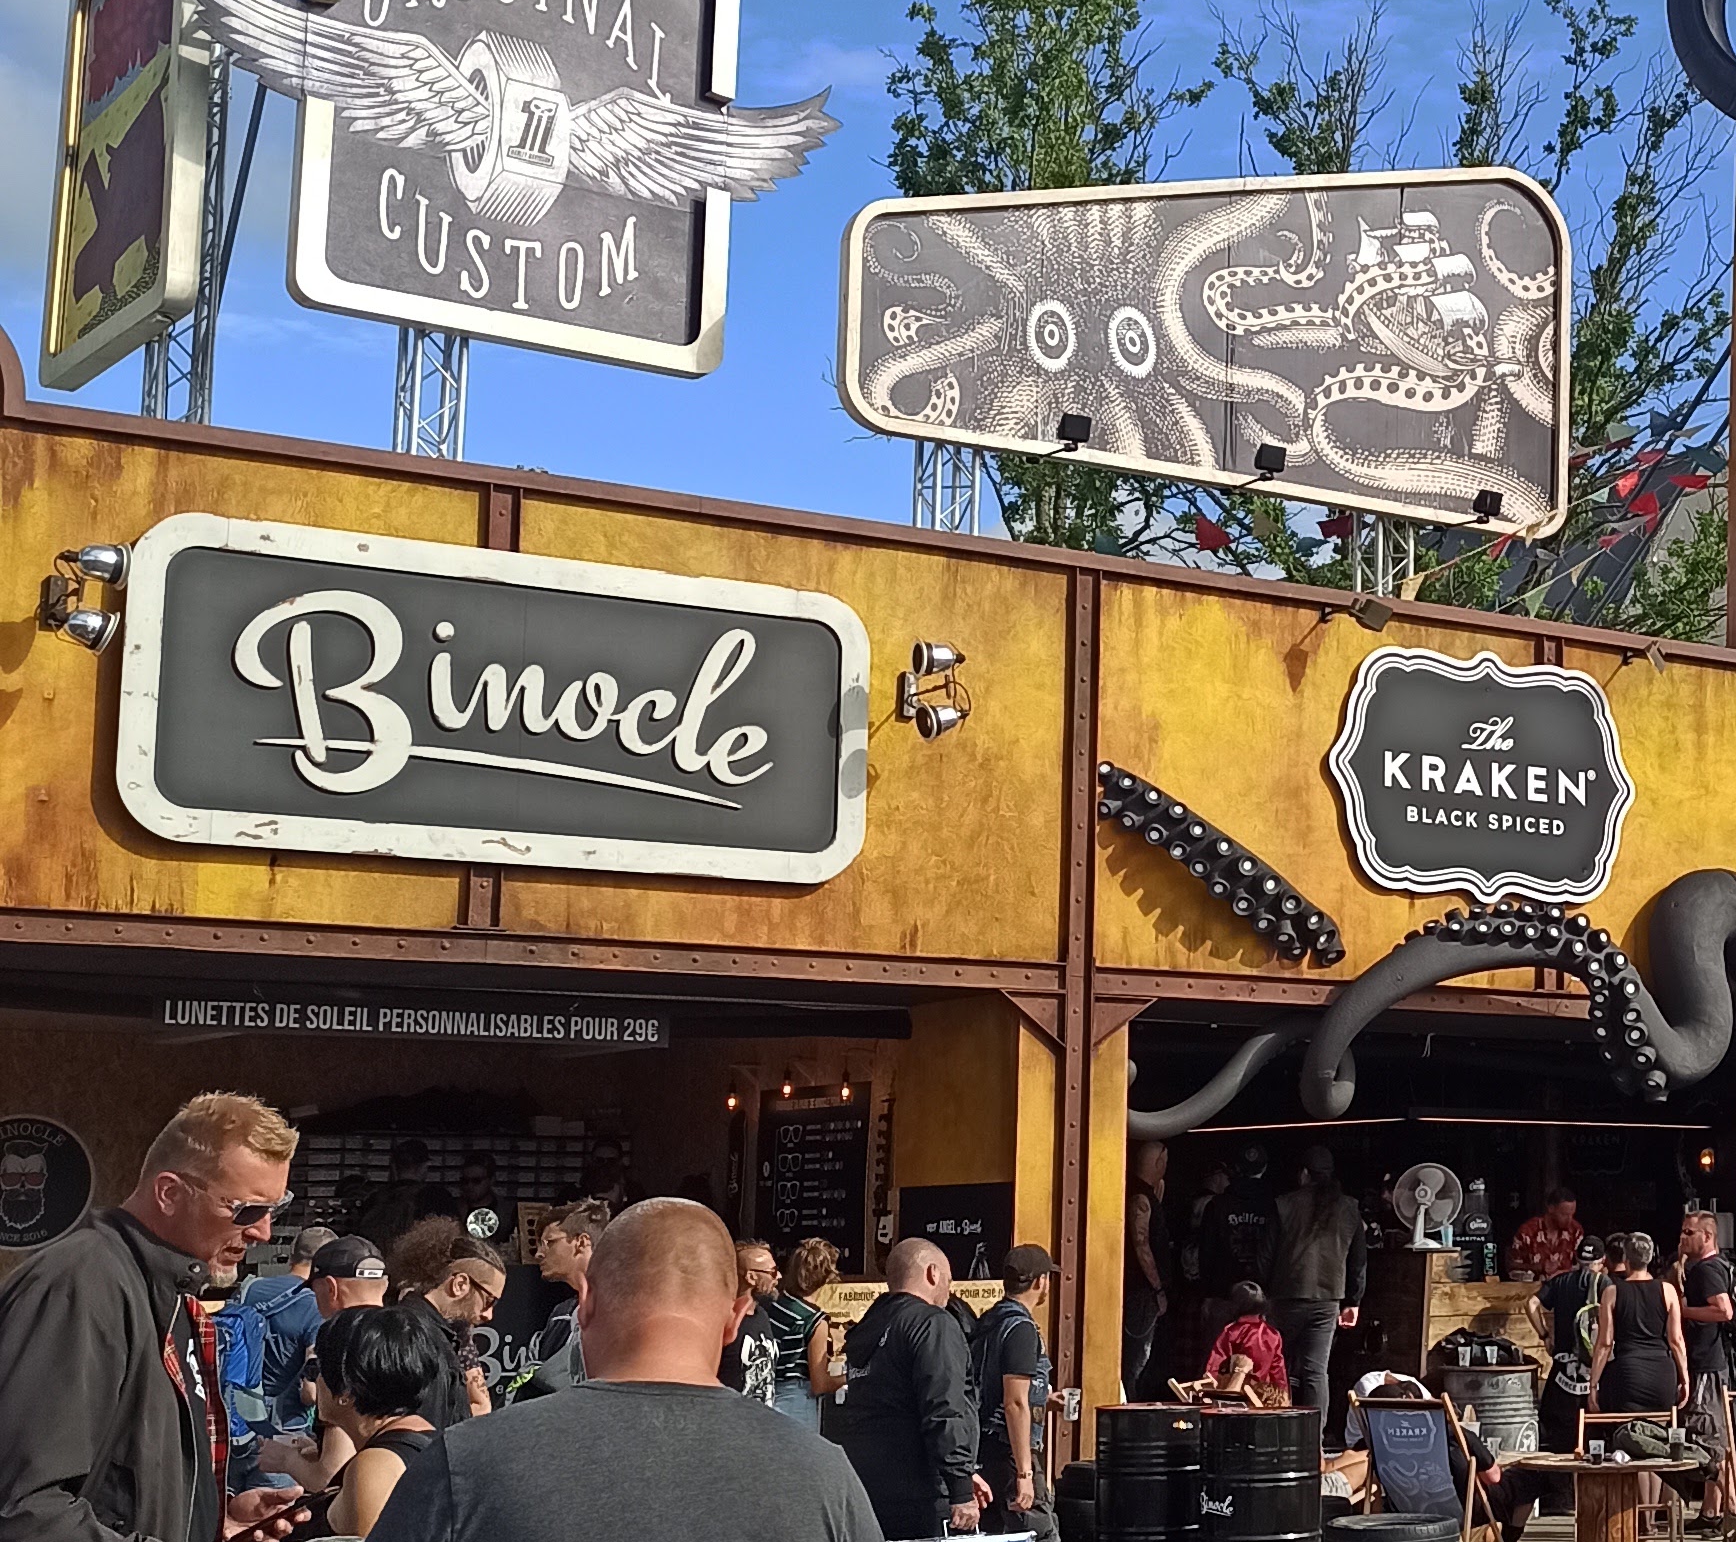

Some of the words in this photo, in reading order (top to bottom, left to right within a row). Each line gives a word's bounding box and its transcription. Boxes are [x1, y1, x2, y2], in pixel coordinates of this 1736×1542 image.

[379, 167, 640, 310] CUSTOM
[234, 590, 774, 794] Binocle
[1461, 716, 1515, 751] The
[1406, 805, 1478, 828] BLACK
[1488, 813, 1565, 836] SPICED
[164, 999, 269, 1027] LUNETTES
[274, 1004, 301, 1028] DE
[305, 1005, 373, 1031] SOLEIL
[378, 1008, 565, 1039] PERSONNALISABLES
[570, 1016, 618, 1041] POUR
[623, 1019, 659, 1042] 29€
[0, 1122, 67, 1147] INOCLE
